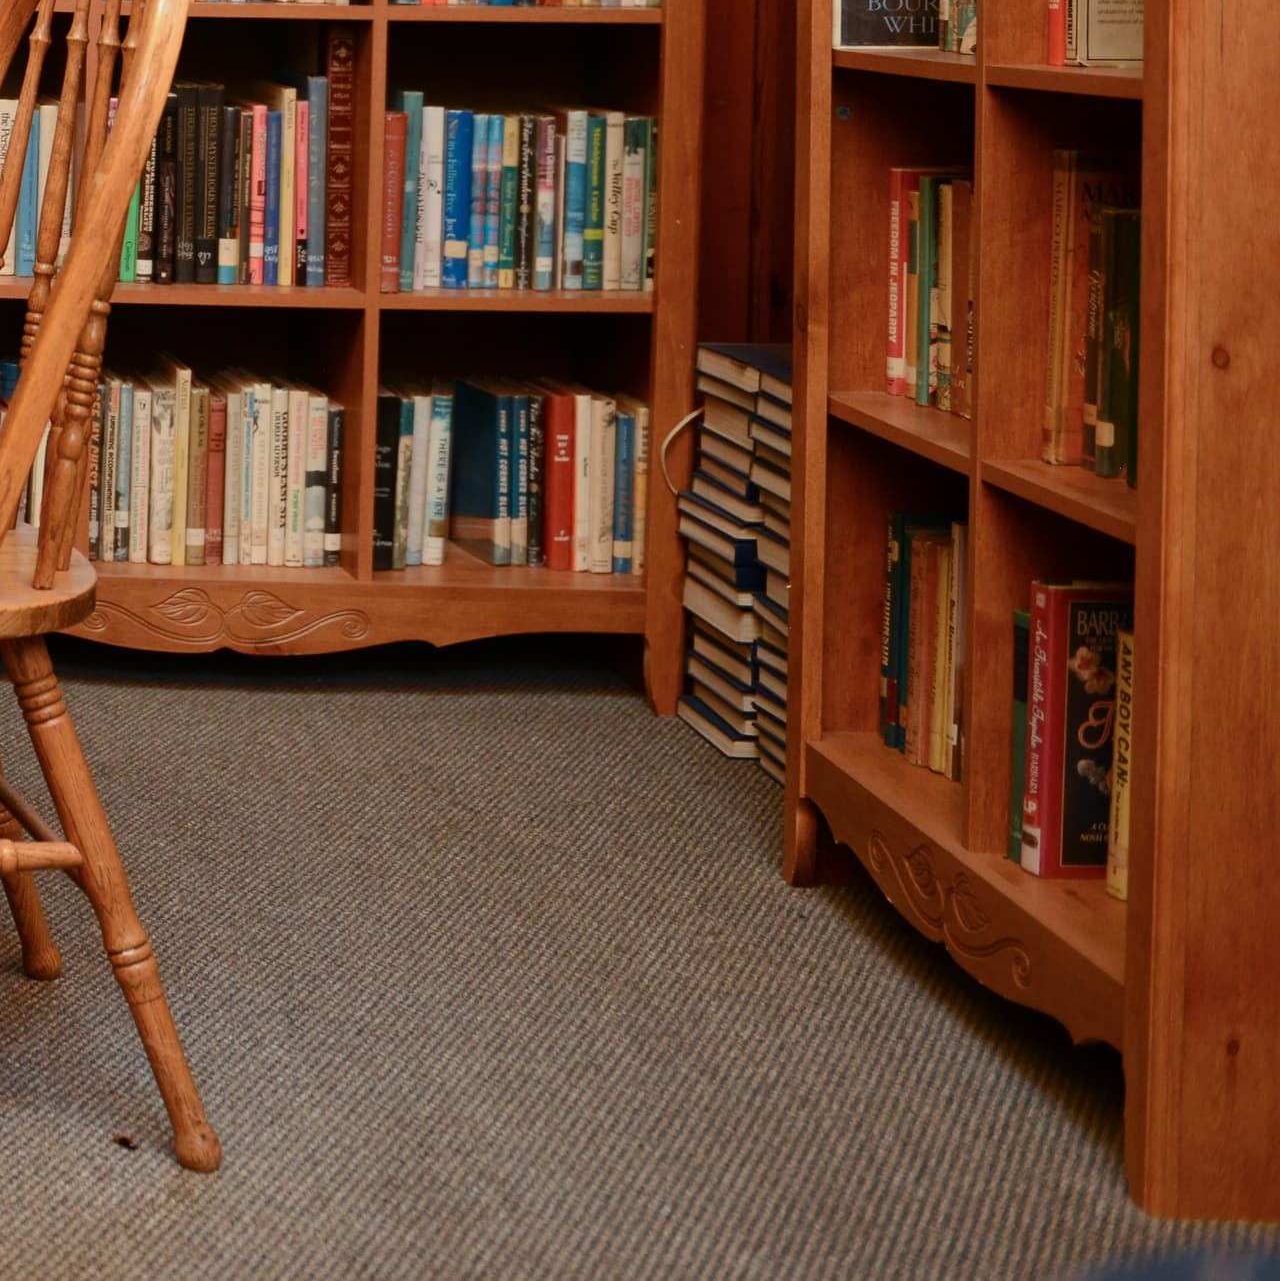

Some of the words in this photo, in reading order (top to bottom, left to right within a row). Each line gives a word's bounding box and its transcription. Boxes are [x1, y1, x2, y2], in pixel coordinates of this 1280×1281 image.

[0, 112, 11, 127] the
[208, 106, 219, 139] THOSE
[206, 140, 218, 202] MYSTERIOUS
[143, 174, 152, 232] PERSONALITY
[205, 204, 217, 239] ETRUSC
[889, 200, 900, 259] FREEDOM
[888, 262, 899, 276] IN
[887, 279, 899, 344] JEOPARDY
[437, 437, 448, 469] THERE
[518, 438, 528, 456] HOT
[436, 472, 446, 483] IS
[518, 458, 528, 494] CORNER
[433, 496, 444, 518] TIDE
[518, 495, 528, 519] BLUE
[1121, 643, 1132, 686] ANY
[1119, 689, 1131, 735] BOY
[1116, 739, 1129, 789] CAN:
